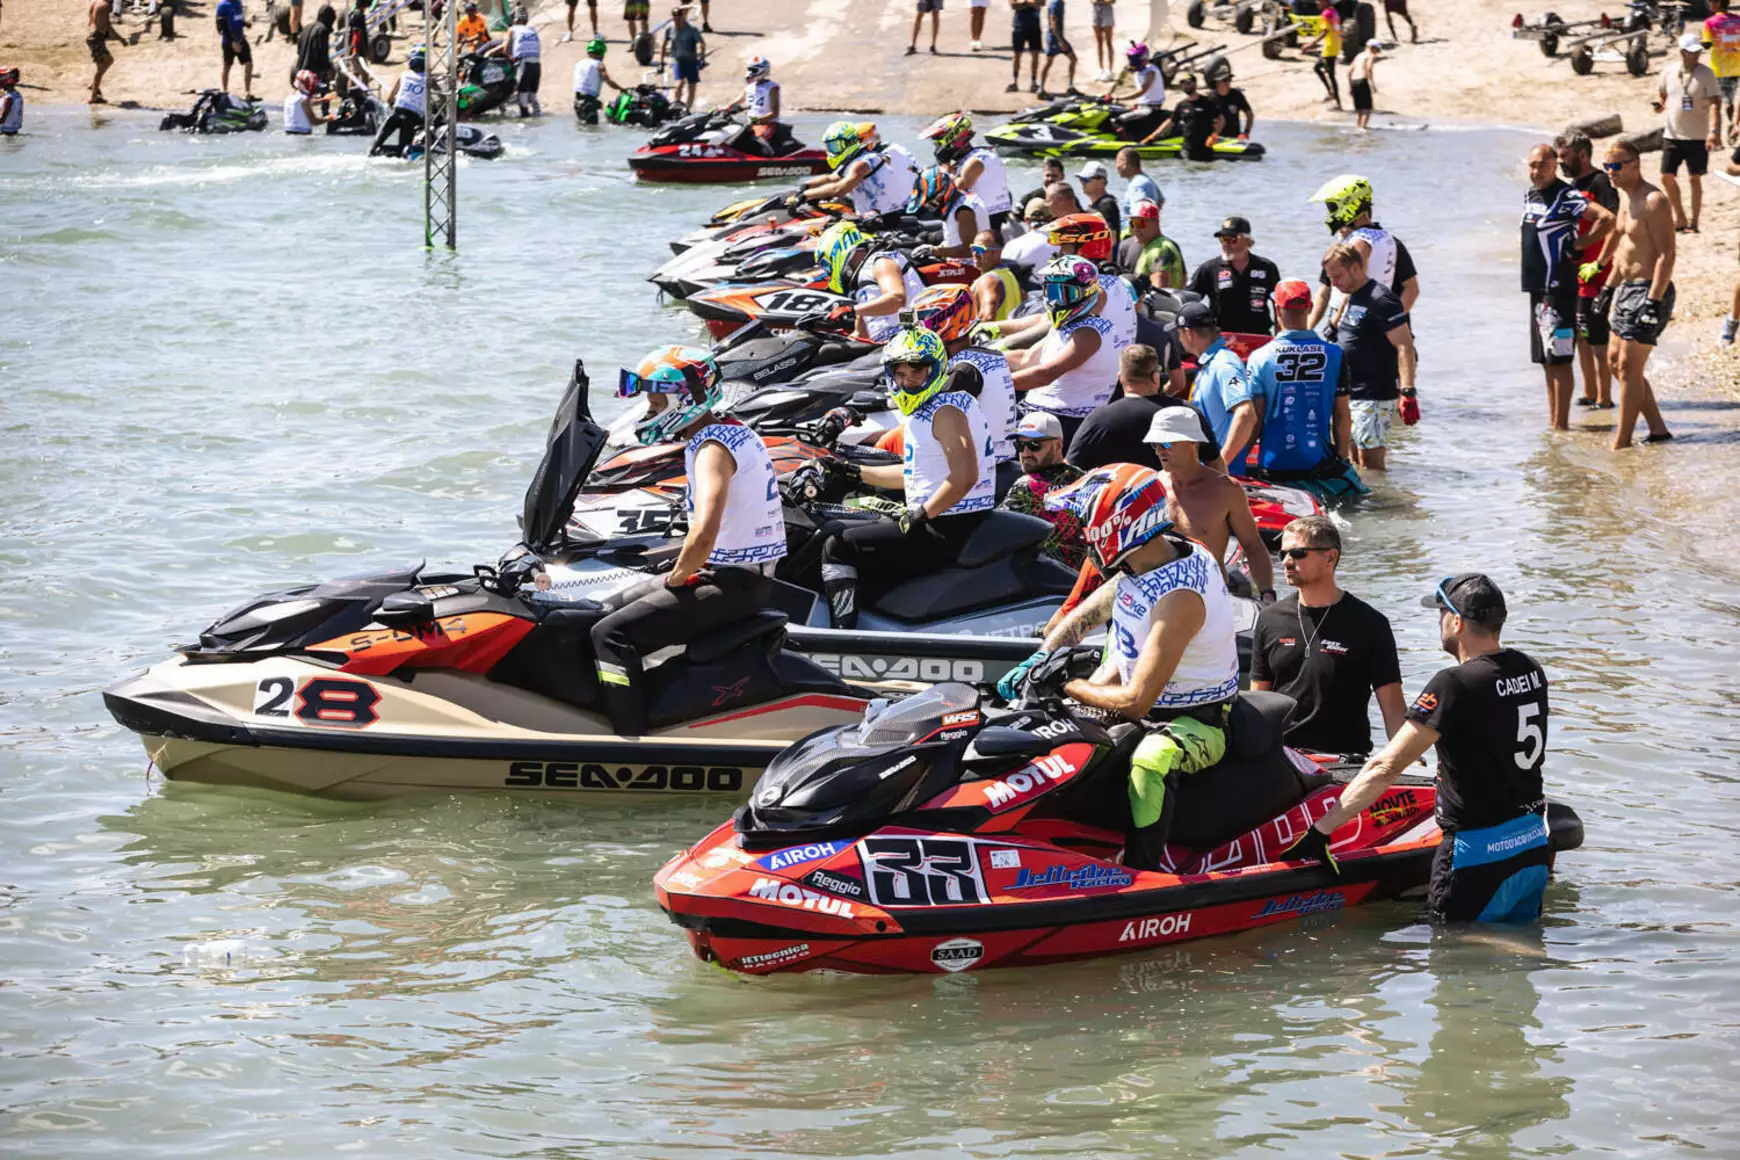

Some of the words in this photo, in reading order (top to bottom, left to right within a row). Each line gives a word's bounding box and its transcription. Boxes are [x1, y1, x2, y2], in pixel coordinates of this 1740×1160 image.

[1274, 353, 1328, 383] 32
[1495, 676, 1531, 697] CADEI
[254, 675, 384, 730] 28
[940, 728, 968, 740] Reggio
[1513, 701, 1544, 770] 5
[983, 753, 1076, 808] MOTUL
[770, 842, 836, 870] AIROH
[748, 877, 856, 919] MOTUL
[811, 871, 861, 896] Reggio
[1118, 913, 1192, 942] AIROH
[937, 947, 978, 960] SAAD
